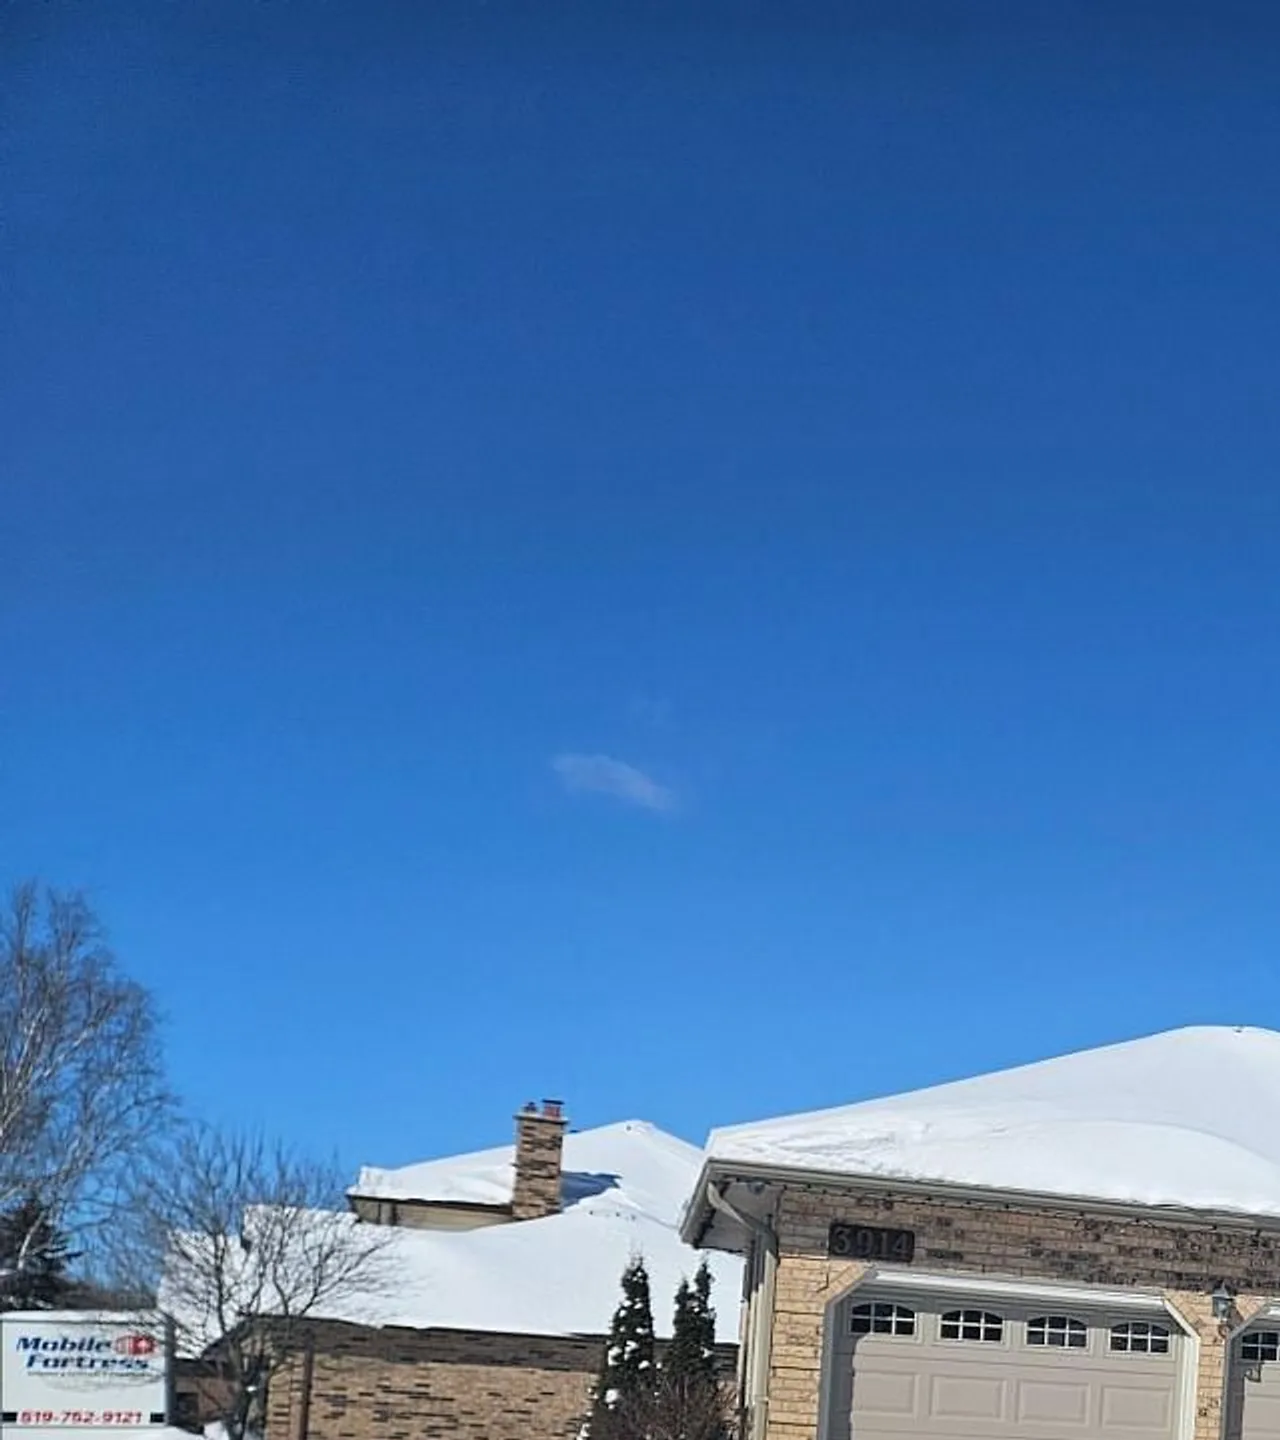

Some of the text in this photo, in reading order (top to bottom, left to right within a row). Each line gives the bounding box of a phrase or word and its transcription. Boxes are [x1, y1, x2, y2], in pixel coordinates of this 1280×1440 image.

[833, 1226, 910, 1258] 3914
[16, 1337, 112, 1352] Mobile
[26, 1354, 149, 1369] Fortress
